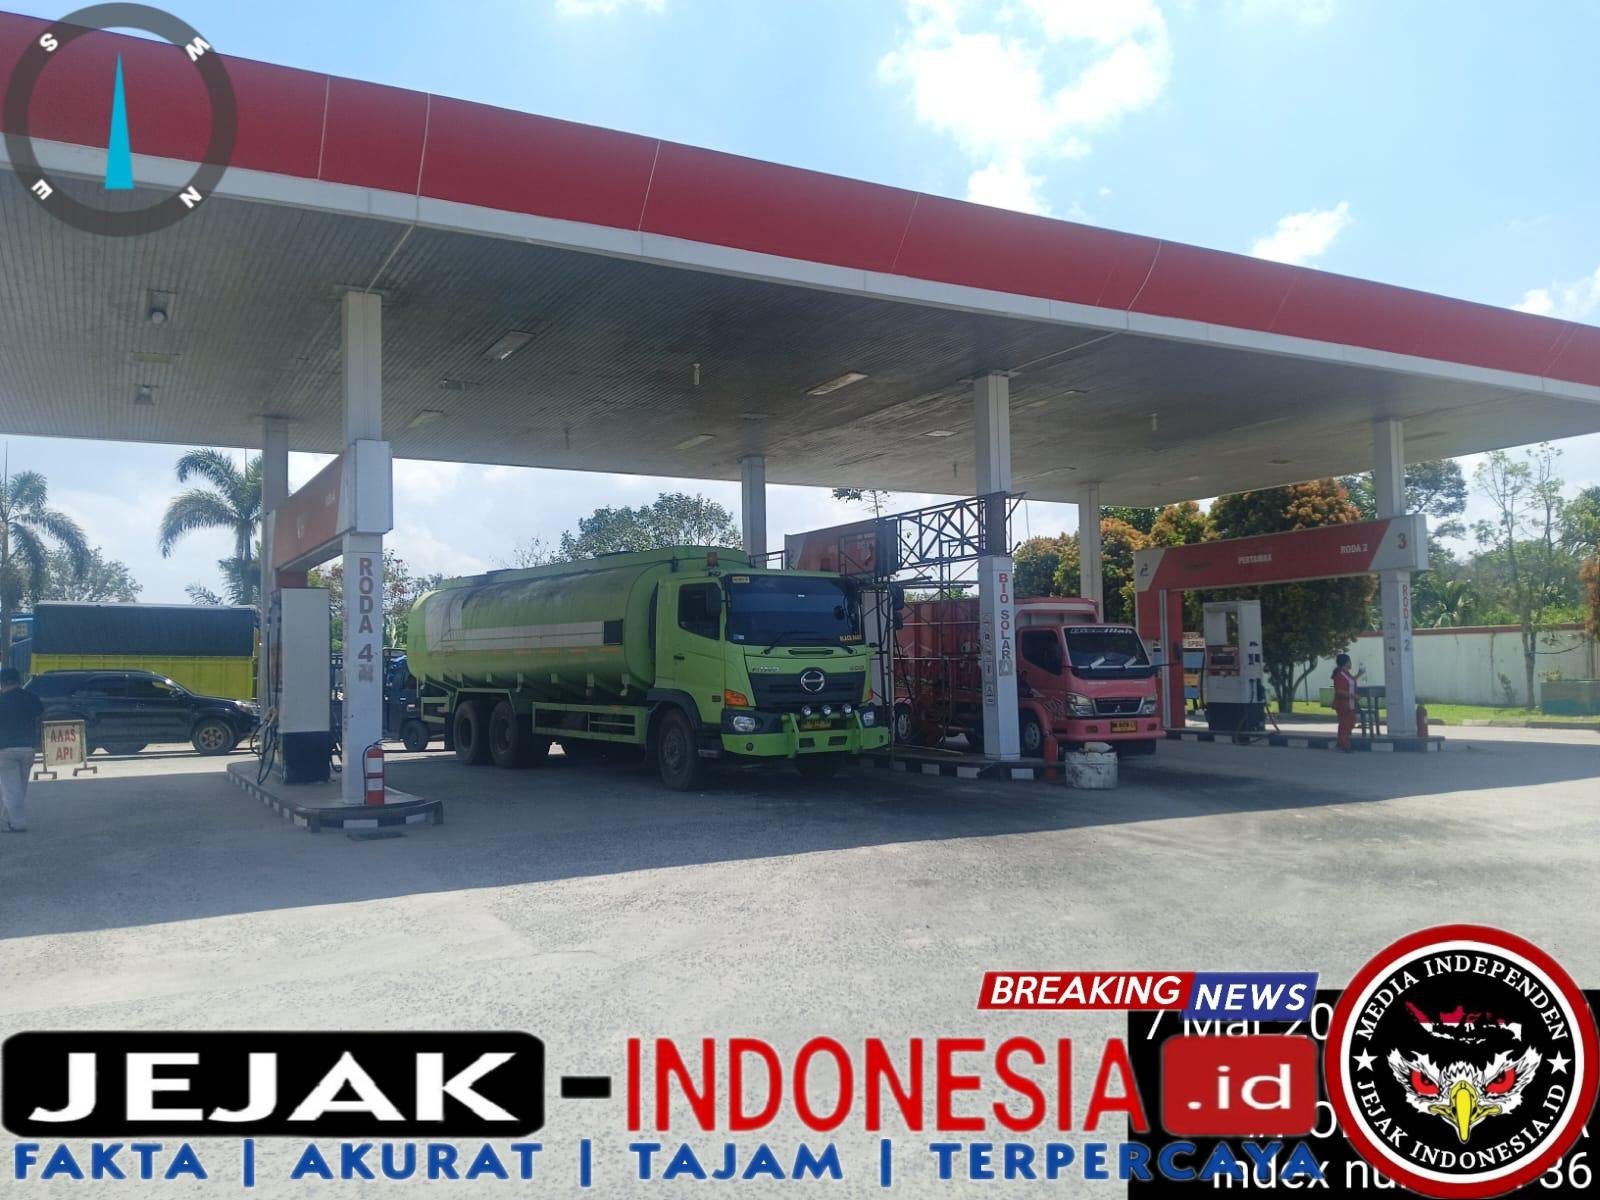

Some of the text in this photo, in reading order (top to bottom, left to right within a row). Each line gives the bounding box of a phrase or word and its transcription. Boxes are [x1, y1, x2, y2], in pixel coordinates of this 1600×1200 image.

[1340, 546, 1361, 554] RODA
[1397, 533, 1408, 549] 3
[359, 557, 373, 634] RODA
[999, 573, 1011, 660] BIO SOLAR
[1402, 584, 1410, 631] RODA
[358, 643, 373, 663] 4
[56, 746, 73, 761] API
